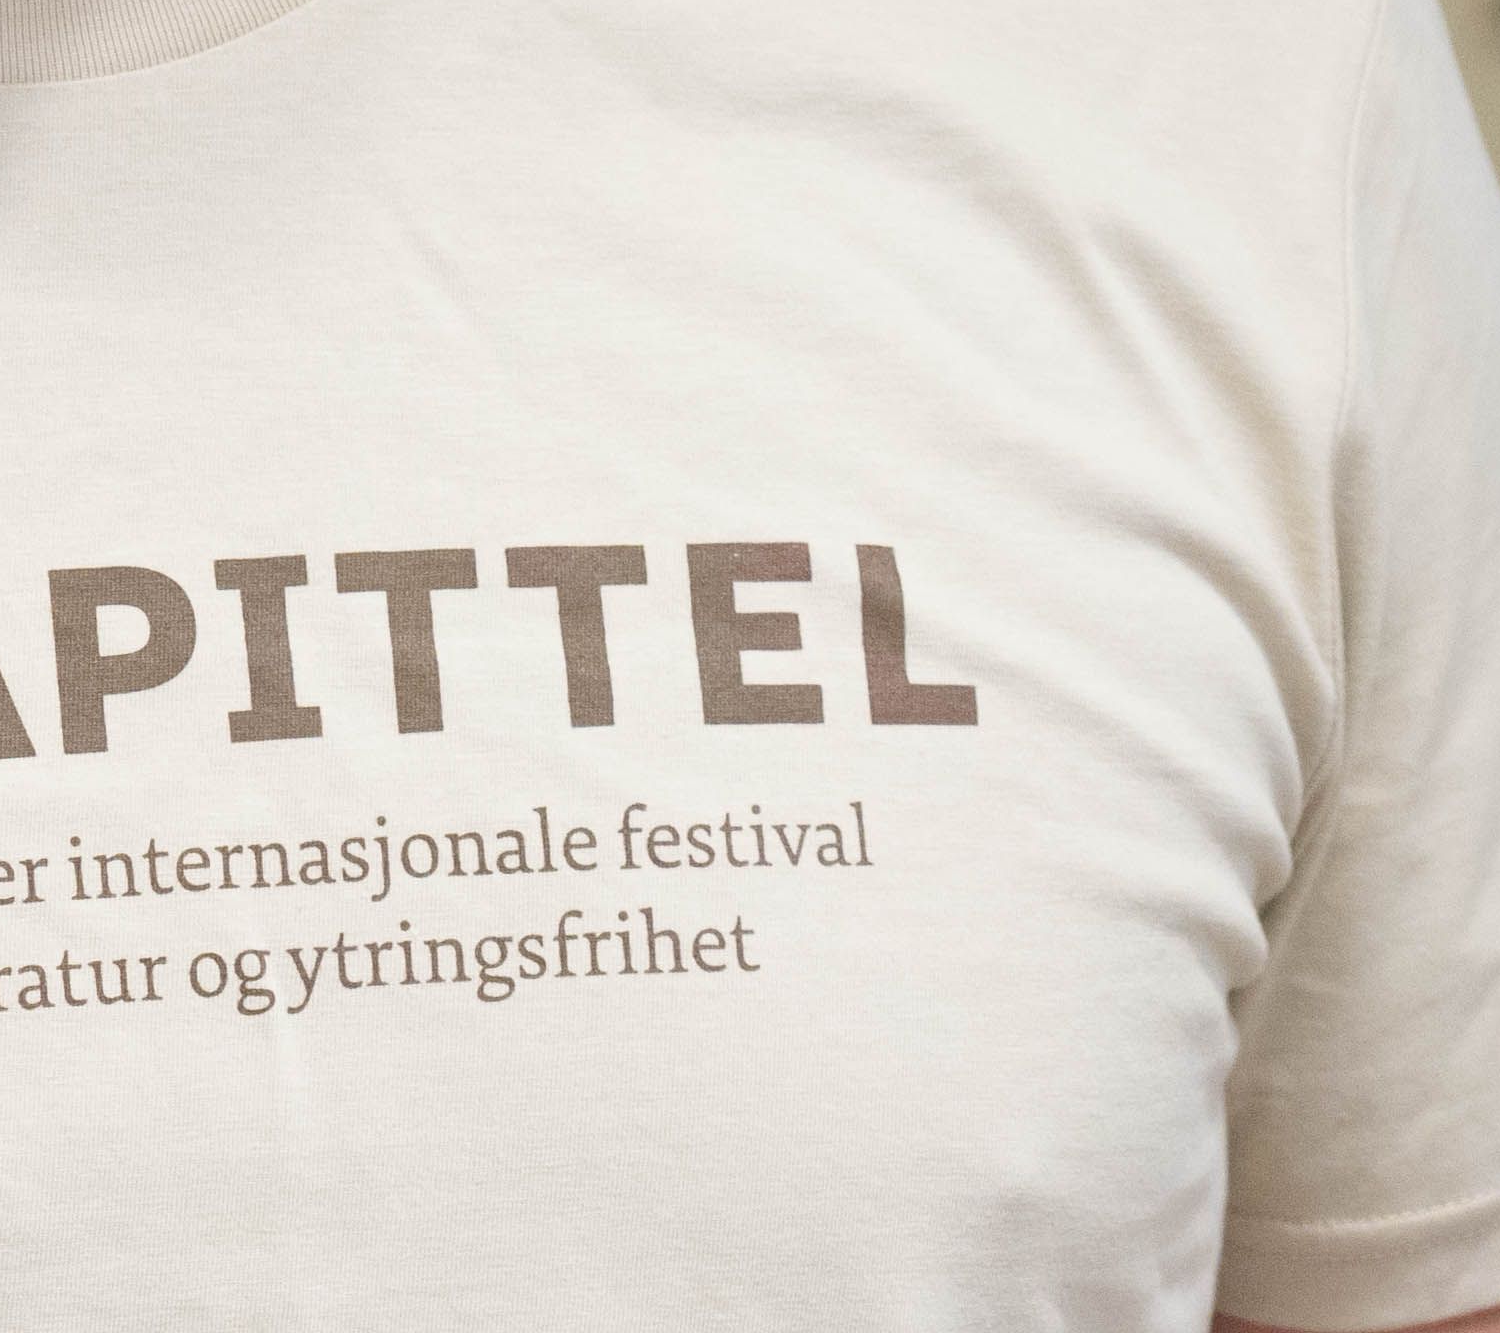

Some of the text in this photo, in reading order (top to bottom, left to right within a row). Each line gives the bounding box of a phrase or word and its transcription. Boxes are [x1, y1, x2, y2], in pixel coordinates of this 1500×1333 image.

[68, 807, 598, 904] internasjonale
[617, 801, 873, 875] festival
[188, 949, 277, 1017] og
[285, 910, 761, 1016] ytringsfrihet
